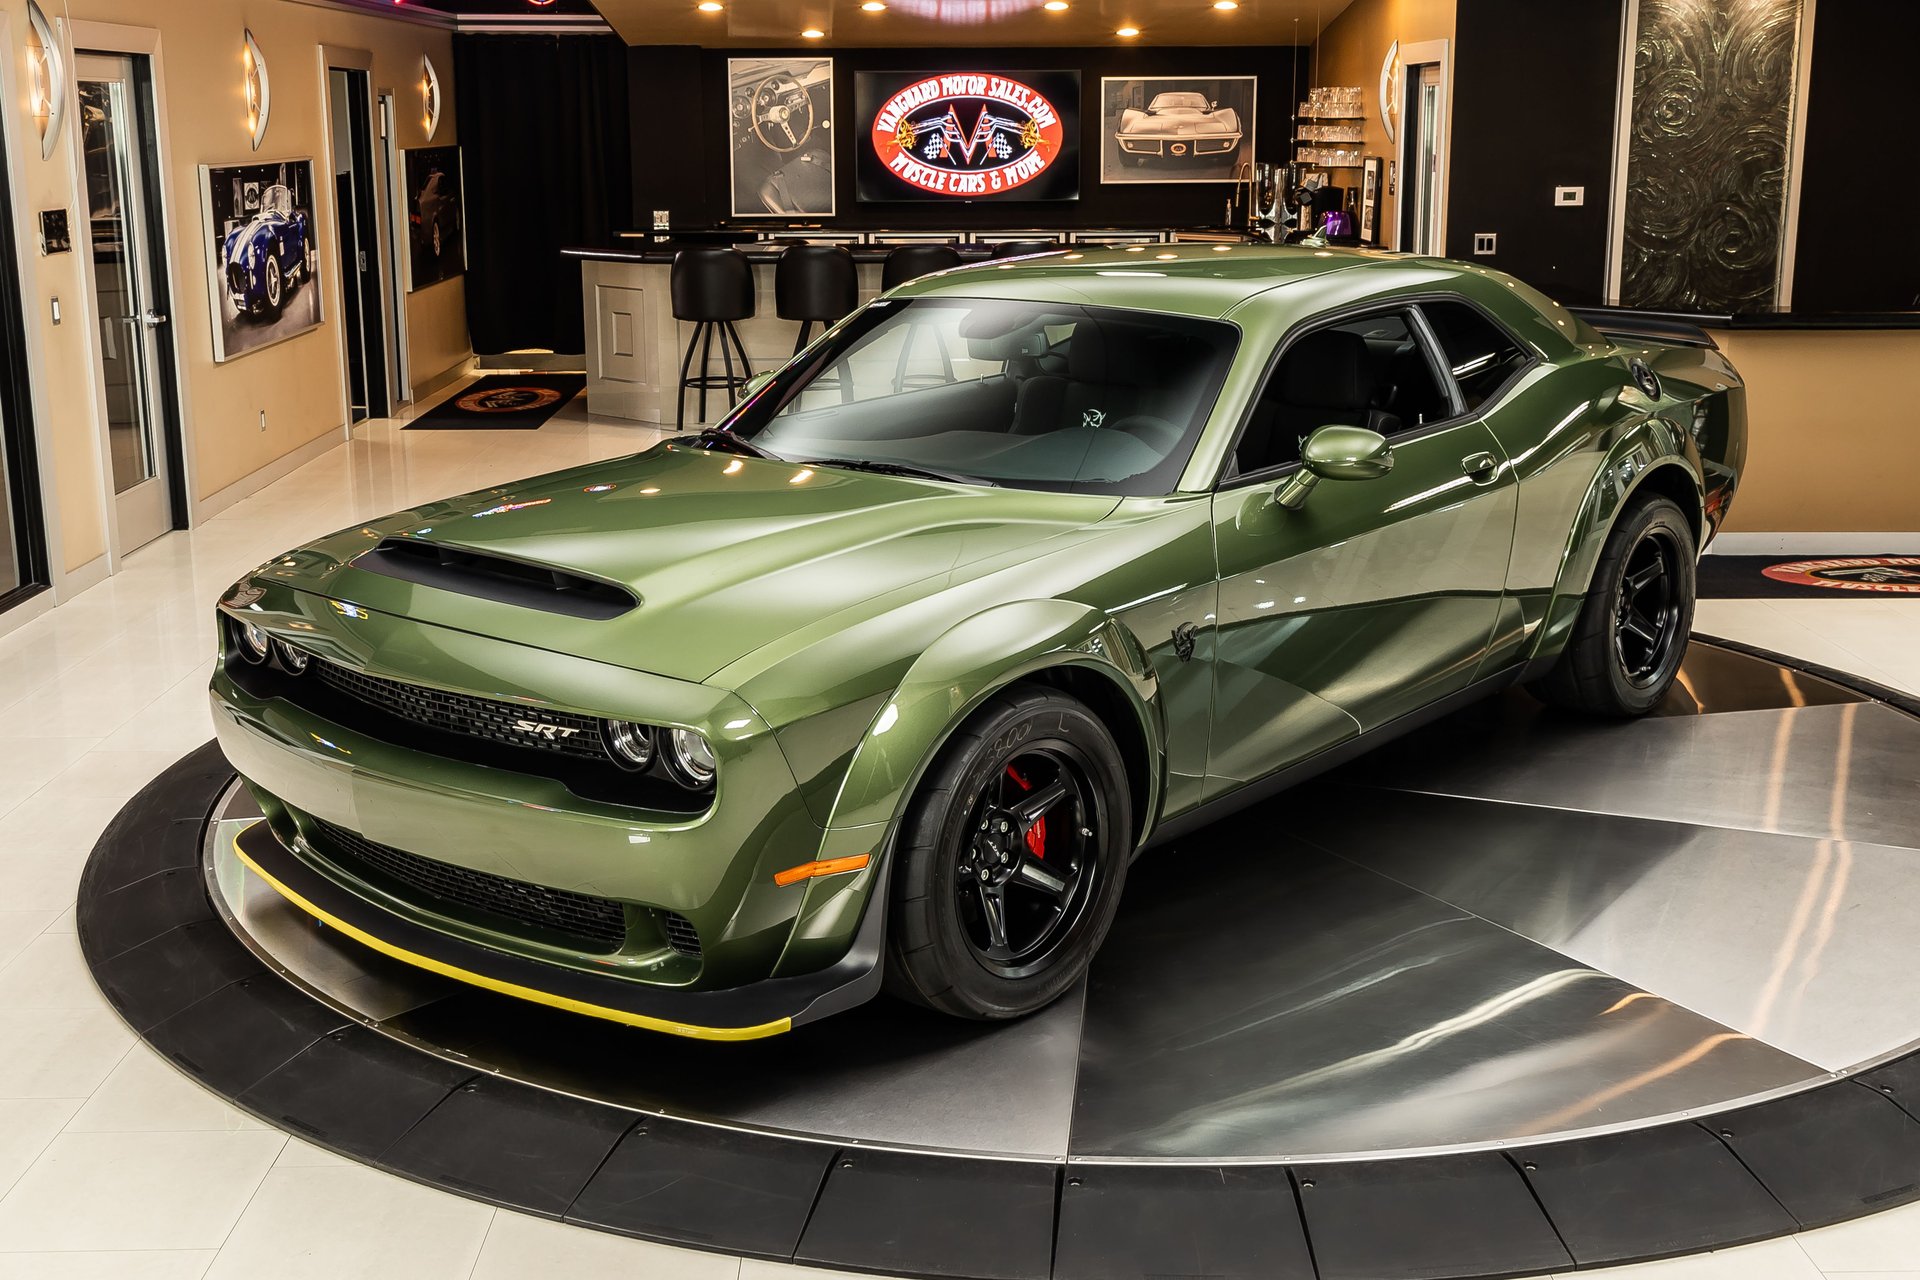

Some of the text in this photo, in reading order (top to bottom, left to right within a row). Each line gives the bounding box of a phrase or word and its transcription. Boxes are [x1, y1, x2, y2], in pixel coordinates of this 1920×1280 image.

[877, 75, 1057, 133] VANGUARD MOTOR SALES.COM
[889, 151, 1046, 193] MUSCLE CARS & MORE
[512, 720, 580, 740] SRT
